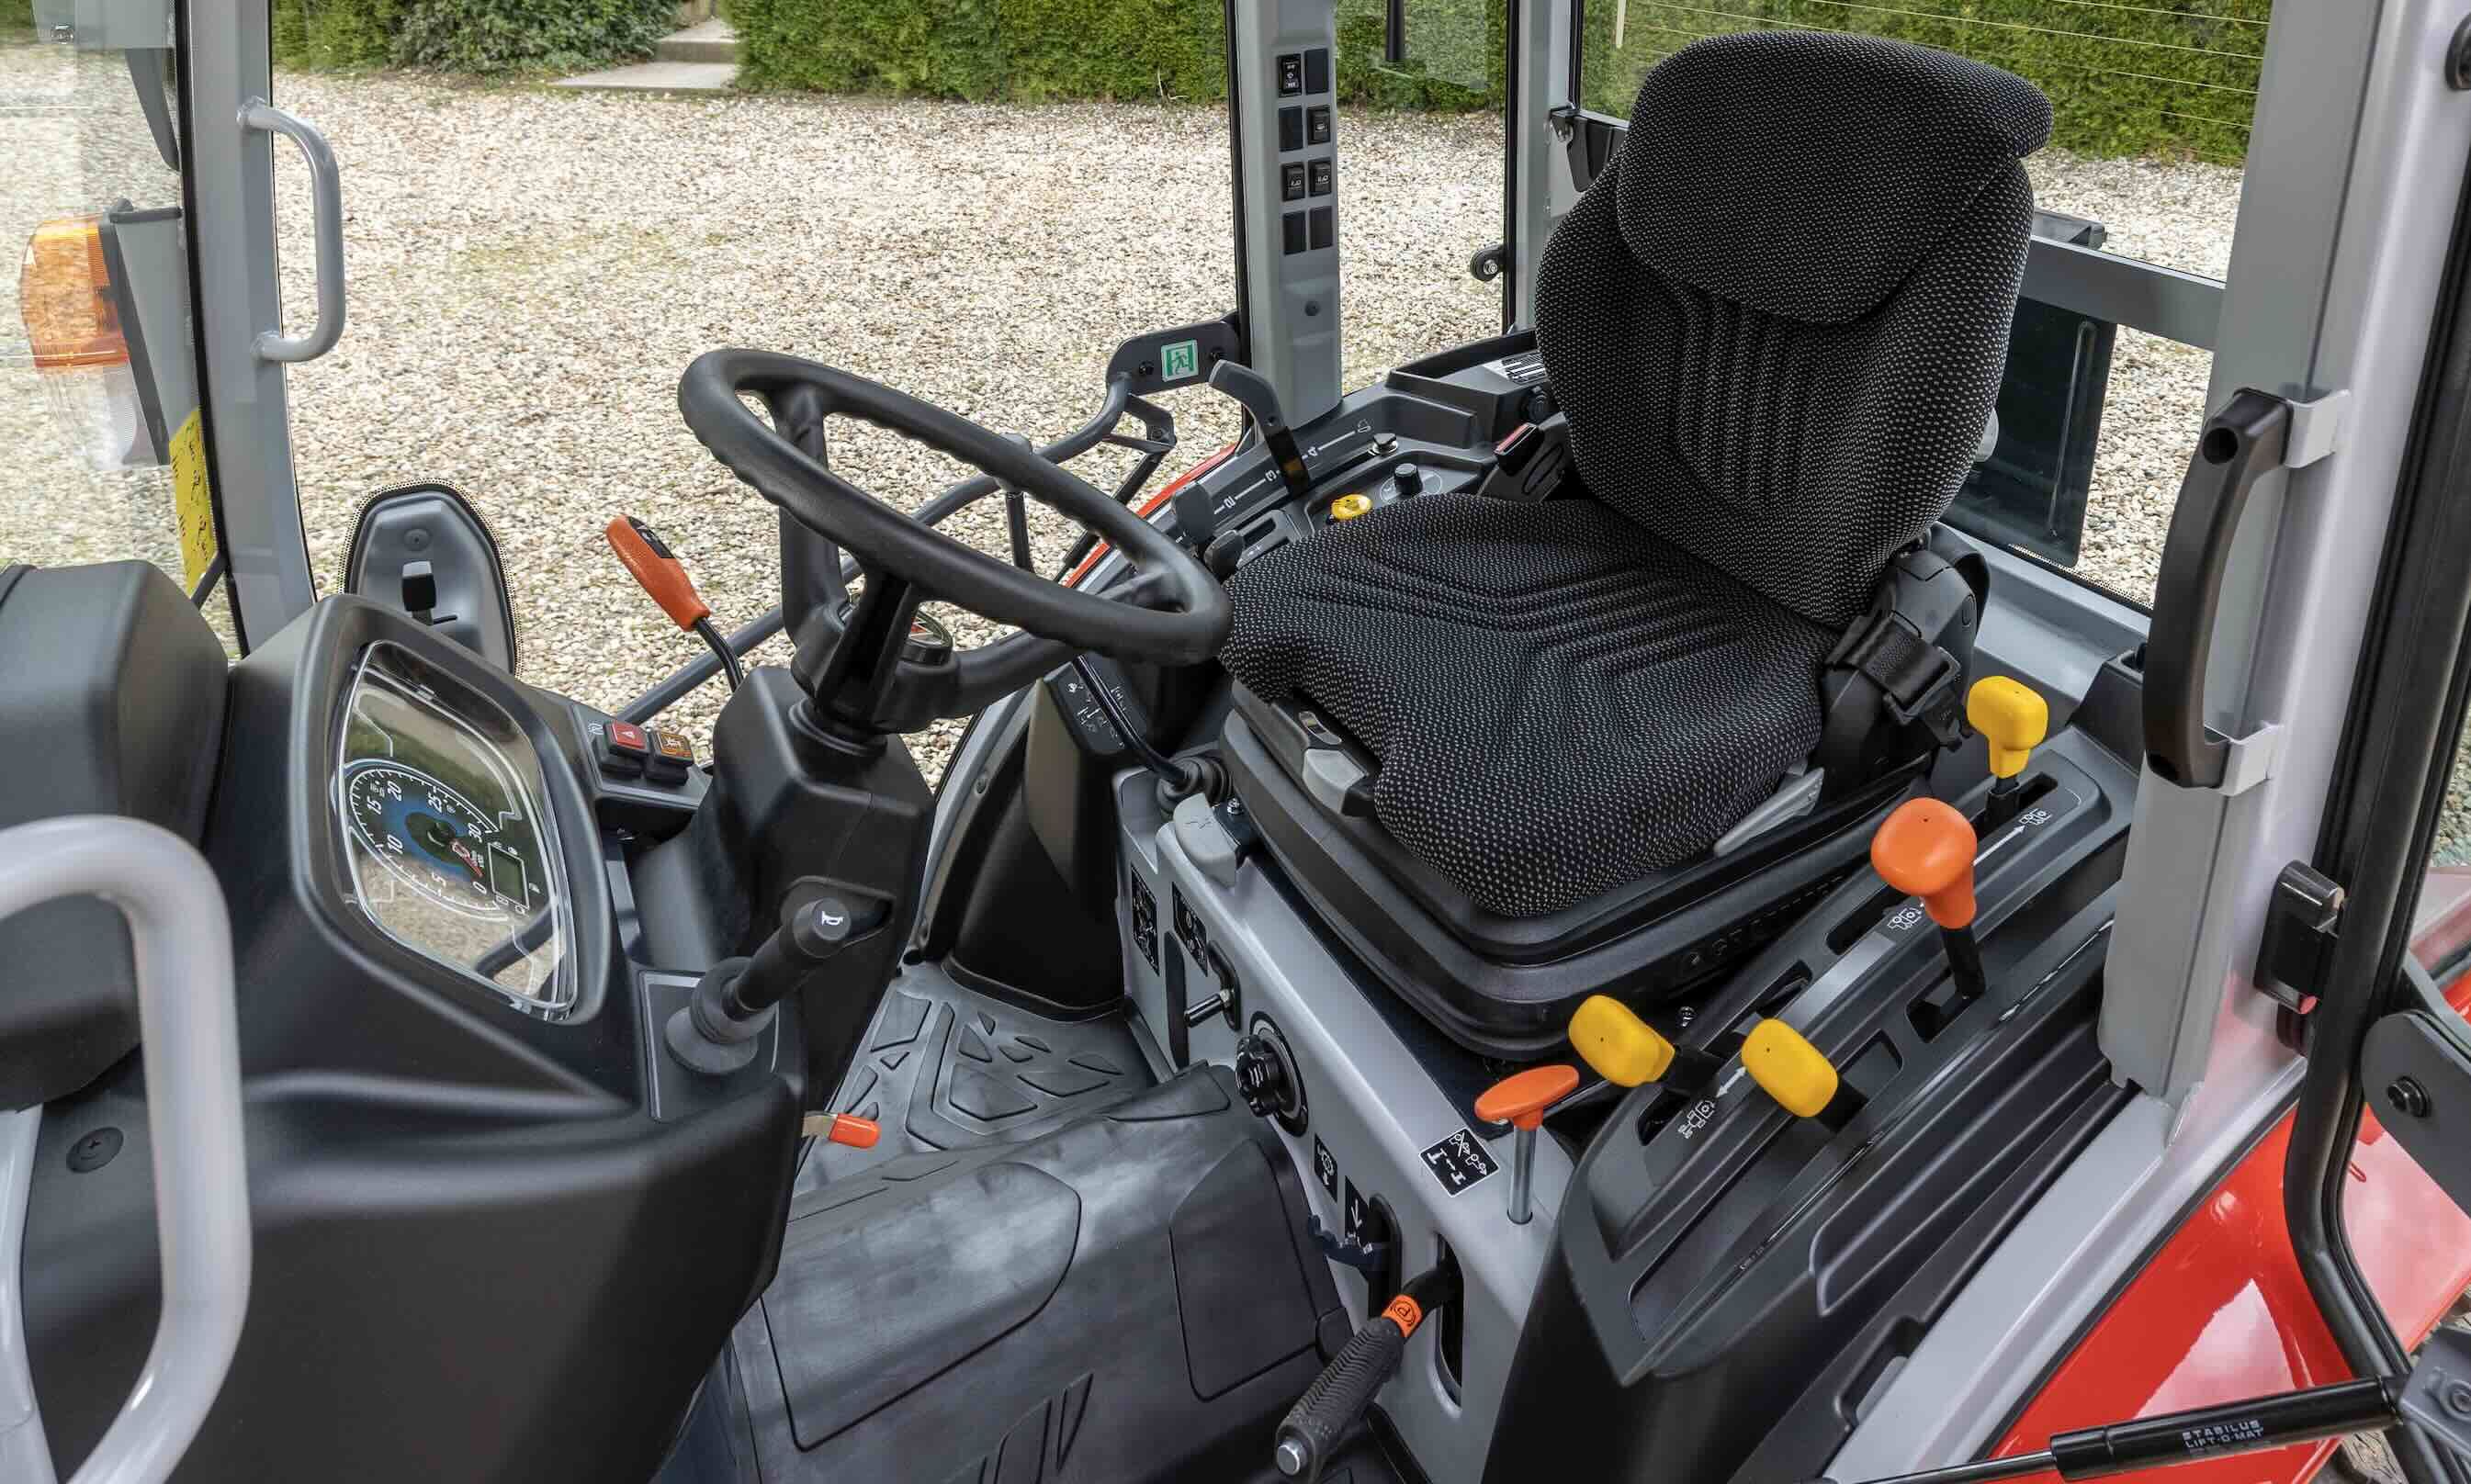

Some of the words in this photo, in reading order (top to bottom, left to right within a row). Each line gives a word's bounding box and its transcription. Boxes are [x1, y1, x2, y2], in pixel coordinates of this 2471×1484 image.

[1308, 446, 1318, 456] 4
[387, 781, 402, 801] 20
[367, 795, 382, 815] 15
[428, 791, 443, 813] 25
[467, 823, 482, 843] 30
[387, 834, 403, 854] 10
[472, 881, 487, 894] 0
[2182, 1420, 2261, 1441] STABILUS
